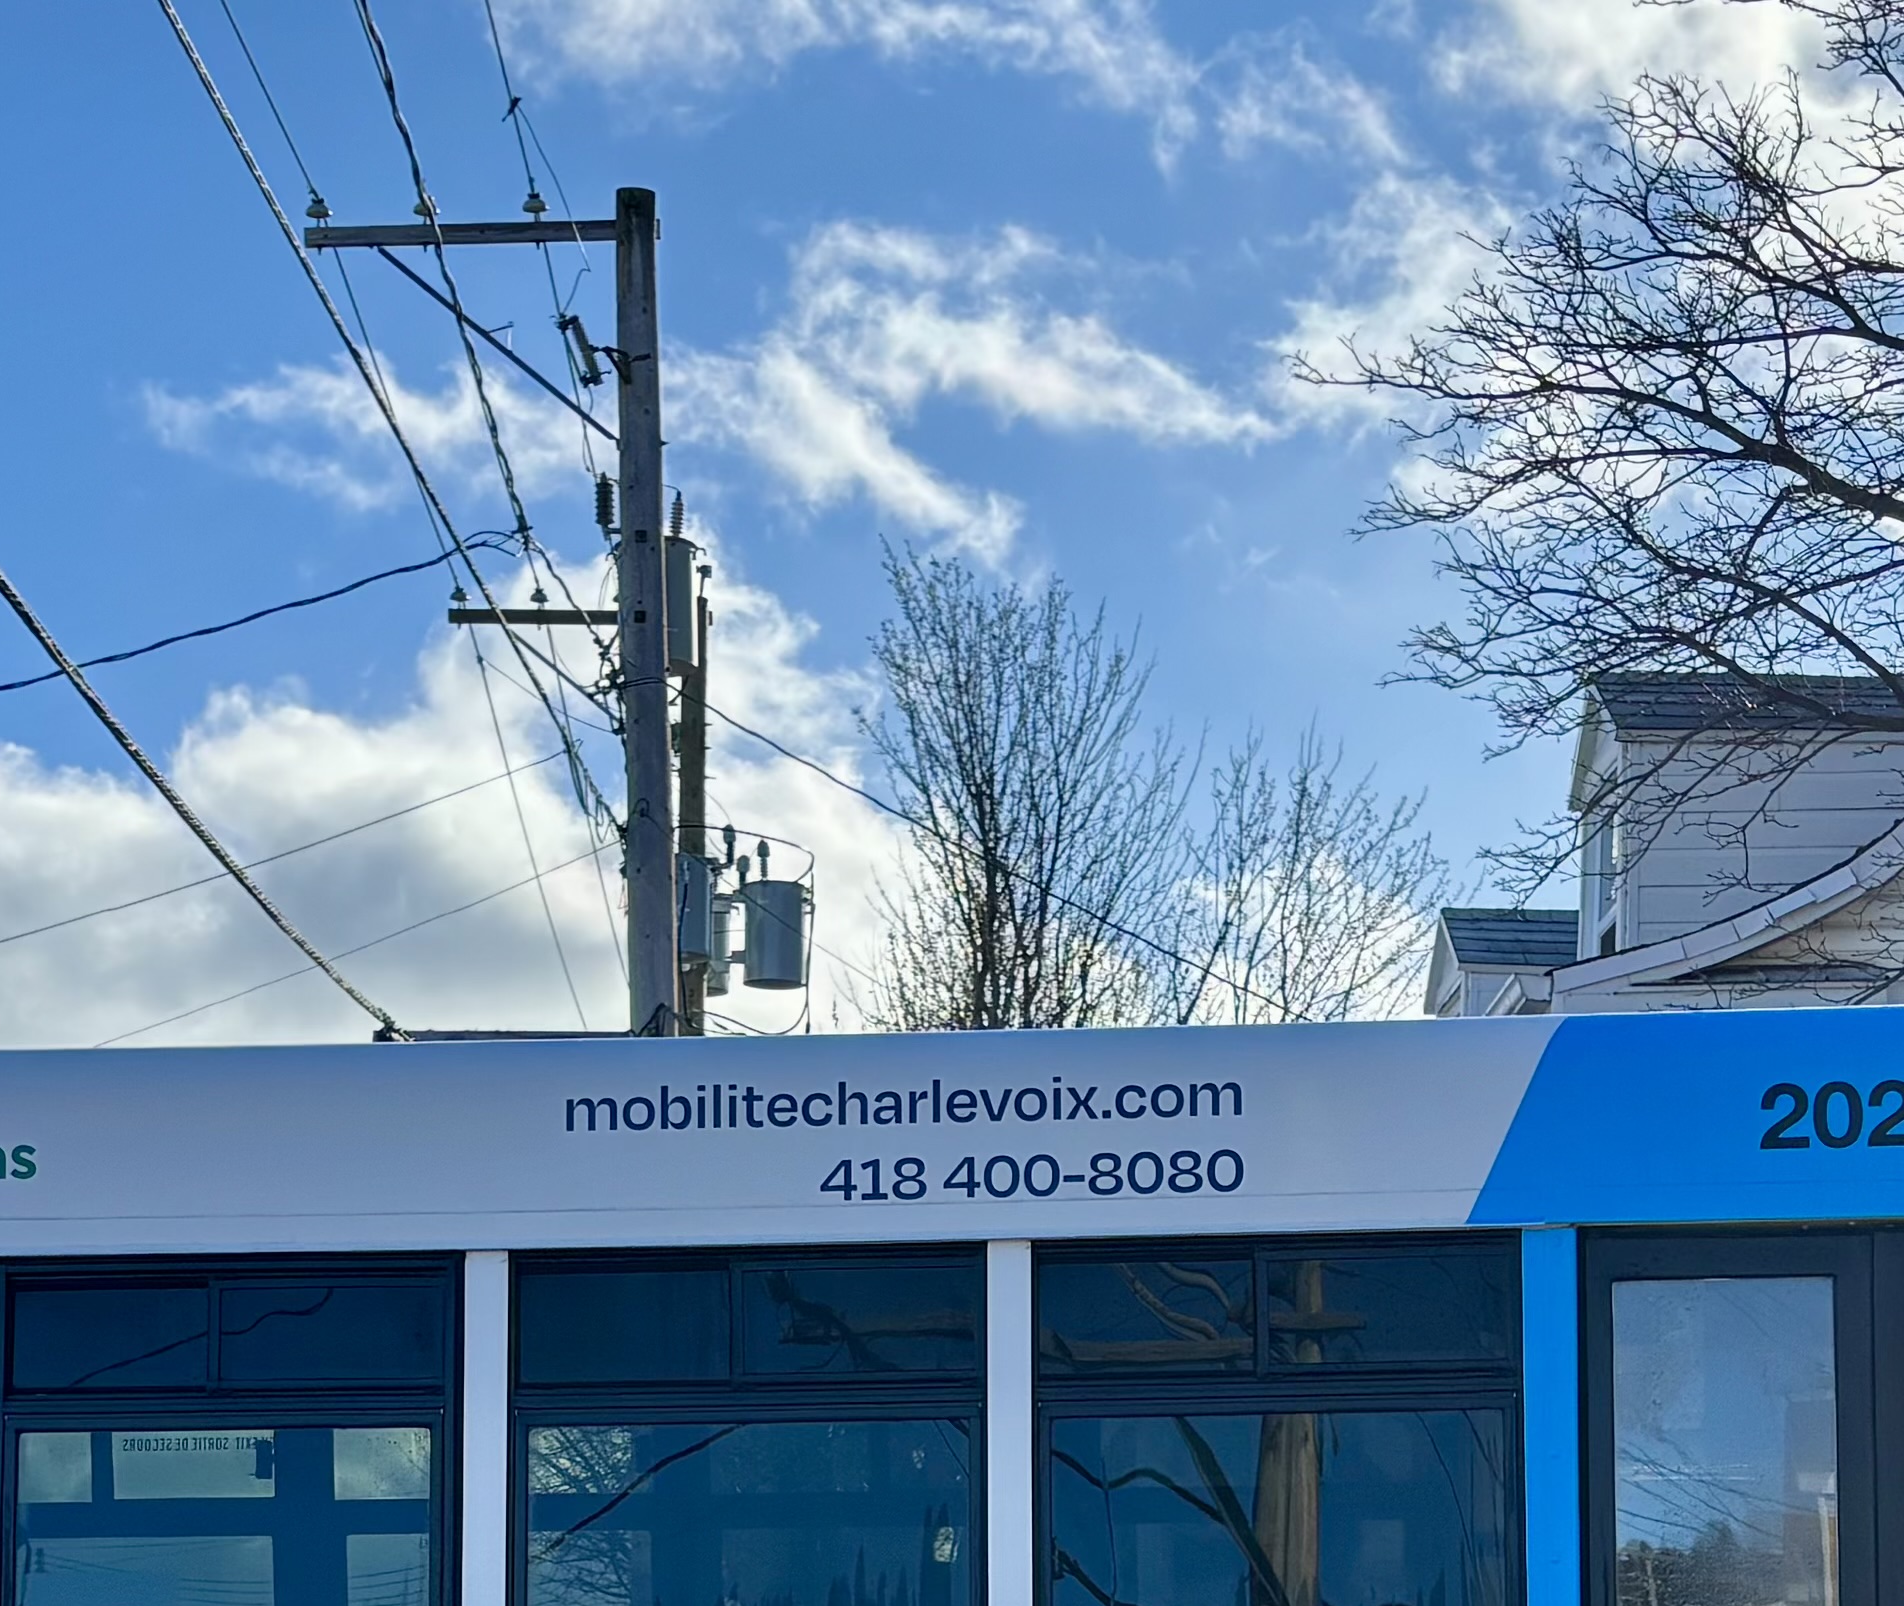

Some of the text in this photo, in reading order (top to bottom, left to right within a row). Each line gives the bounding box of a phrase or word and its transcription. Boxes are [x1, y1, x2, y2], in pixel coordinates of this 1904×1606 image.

[565, 1076, 1244, 1132] mobilitecharlevoix.com
[819, 1148, 1245, 1201] 418 400-8080
